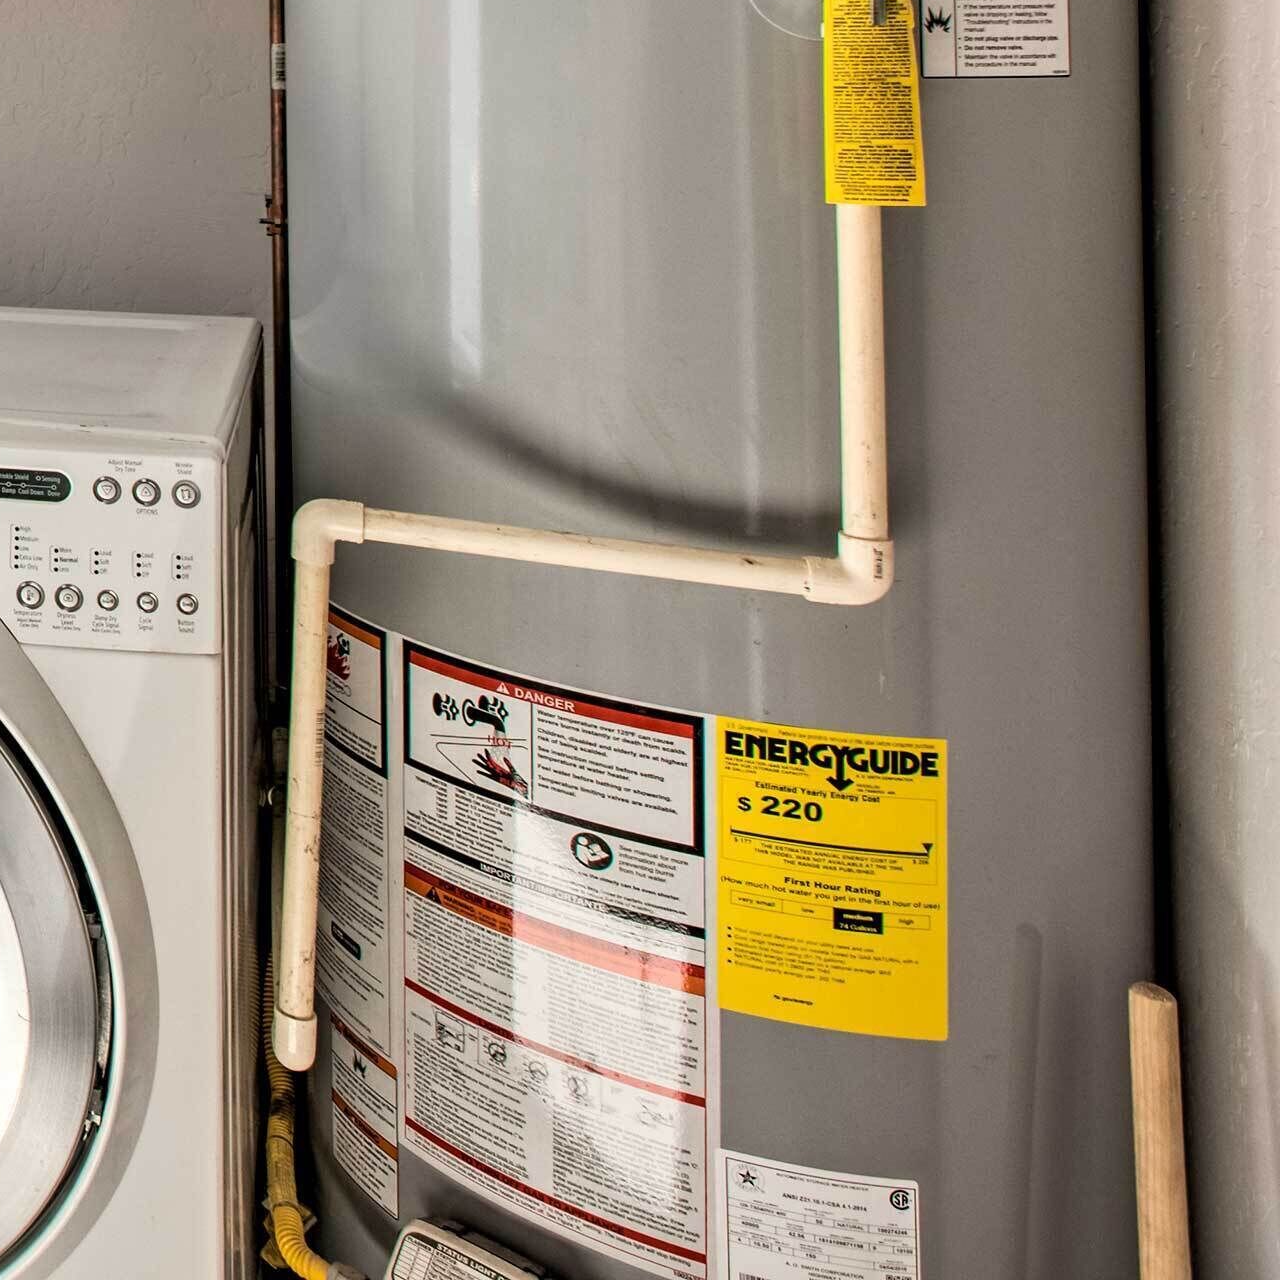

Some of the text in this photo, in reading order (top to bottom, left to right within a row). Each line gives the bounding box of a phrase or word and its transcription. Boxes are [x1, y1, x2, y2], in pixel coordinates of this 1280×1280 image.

[514, 687, 576, 713] DANGER
[725, 730, 939, 789] ENERGYGUIDE
[755, 781, 880, 803] Estimated Yearly Energy Cost
[737, 795, 823, 822] $ 220
[721, 876, 742, 885] (How
[745, 879, 769, 889] much
[772, 884, 787, 893] hot
[788, 887, 812, 897] water
[815, 892, 830, 900] you
[833, 894, 846, 902] get
[859, 896, 871, 904] the
[874, 898, 889, 906] first
[892, 900, 911, 908] hour
[913, 901, 922, 909] of
[924, 902, 941, 910] use)
[784, 876, 881, 897] First Hour Rating
